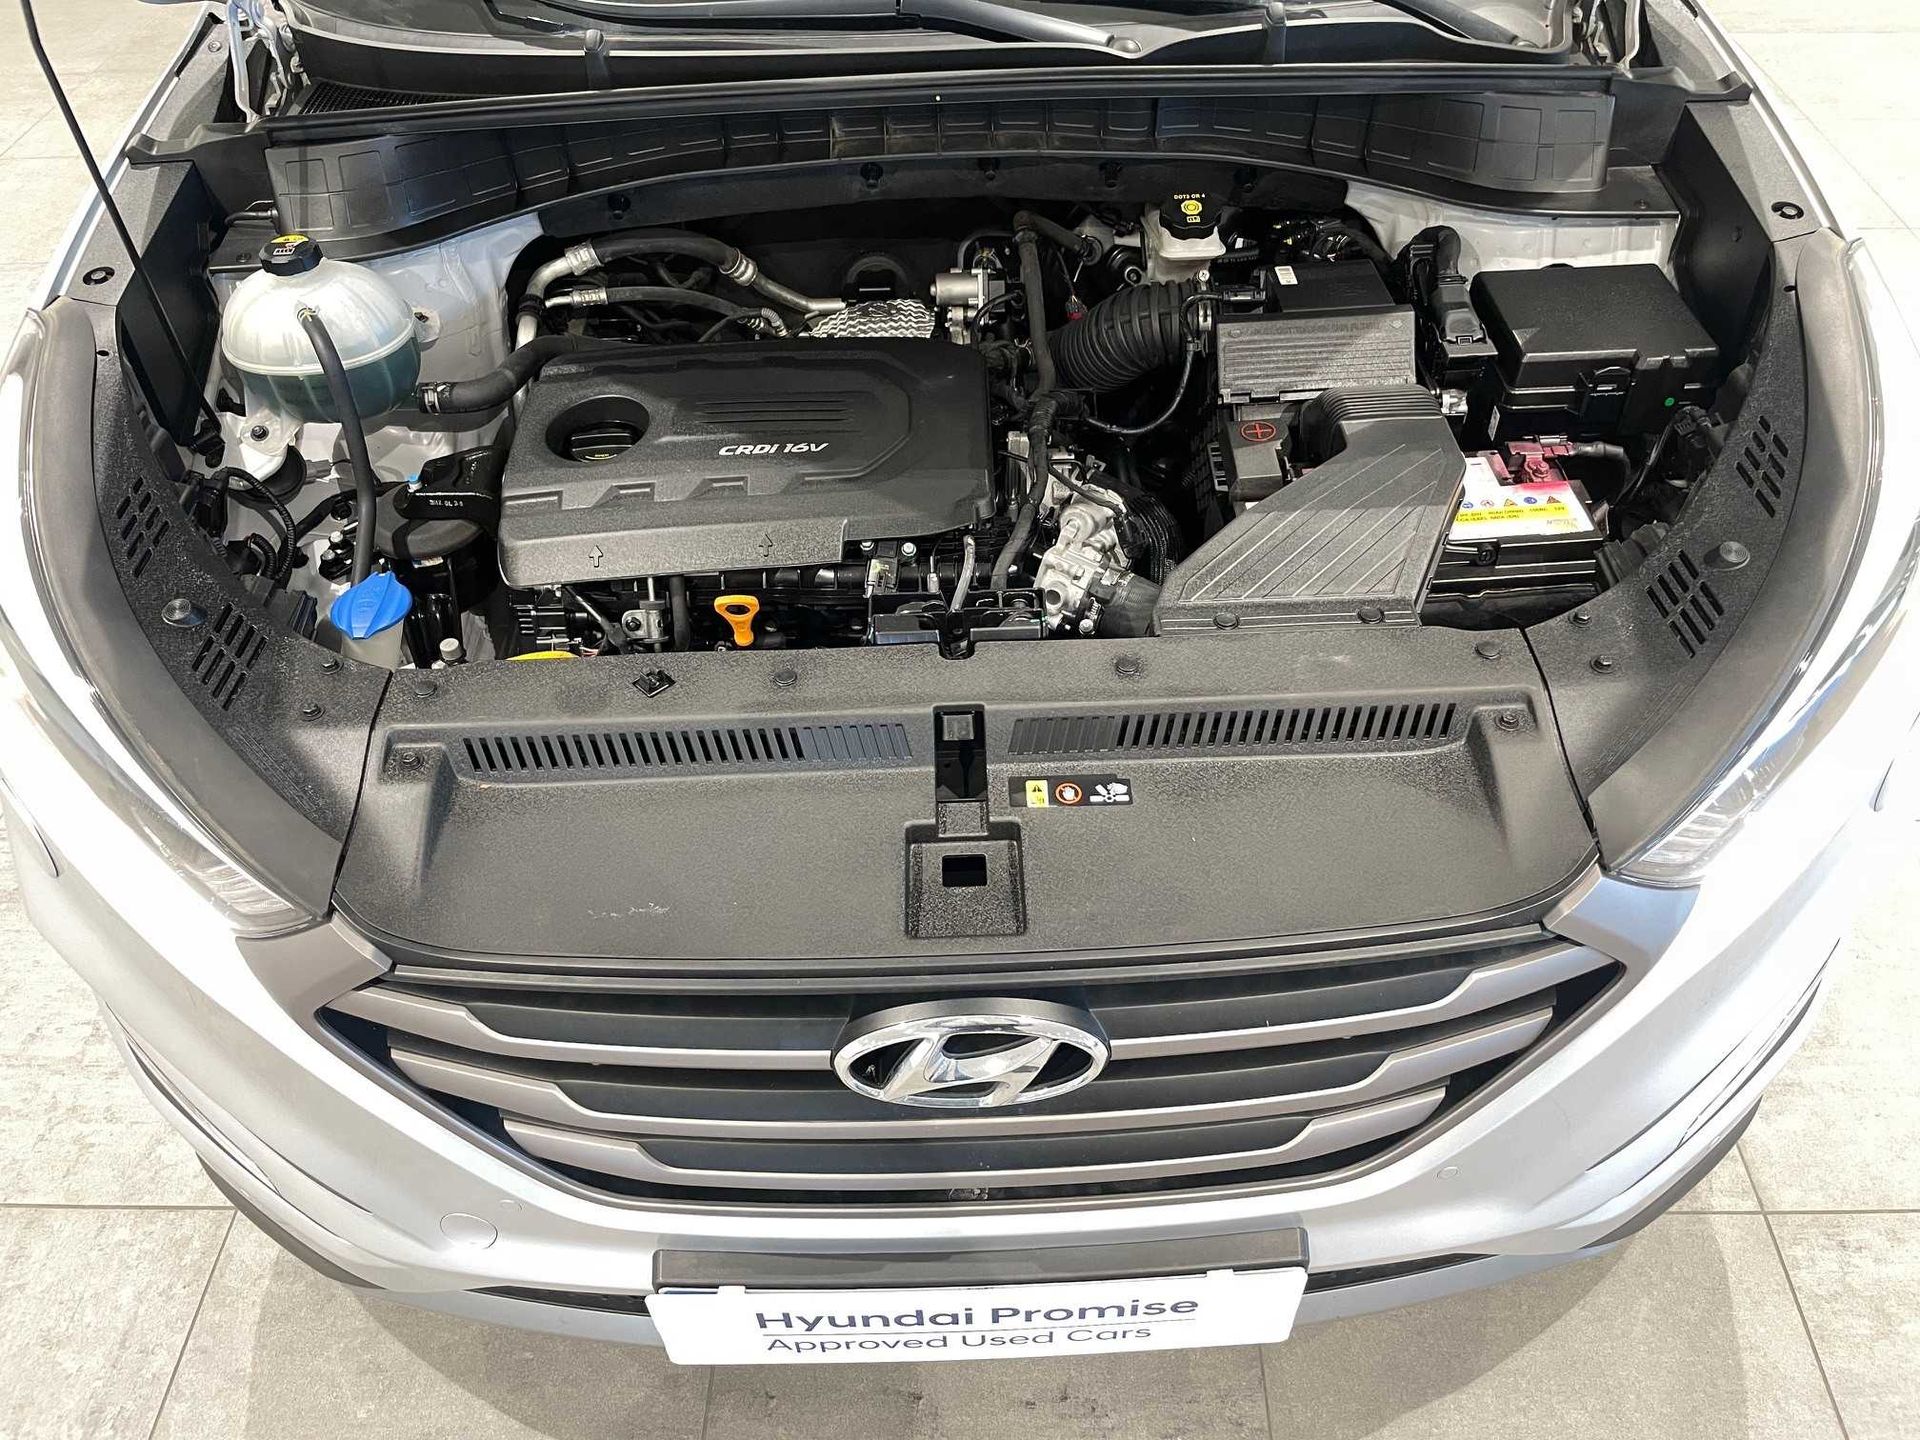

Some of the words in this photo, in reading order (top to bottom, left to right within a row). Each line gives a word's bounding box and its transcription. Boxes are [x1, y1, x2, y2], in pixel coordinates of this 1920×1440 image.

[783, 442, 829, 453] 16V
[755, 1307, 974, 1333] Hyundai
[990, 1298, 1200, 1325] Promise
[766, 1334, 949, 1354] Approved
[961, 1330, 1055, 1348] Used
[1066, 1325, 1153, 1343] Cars
